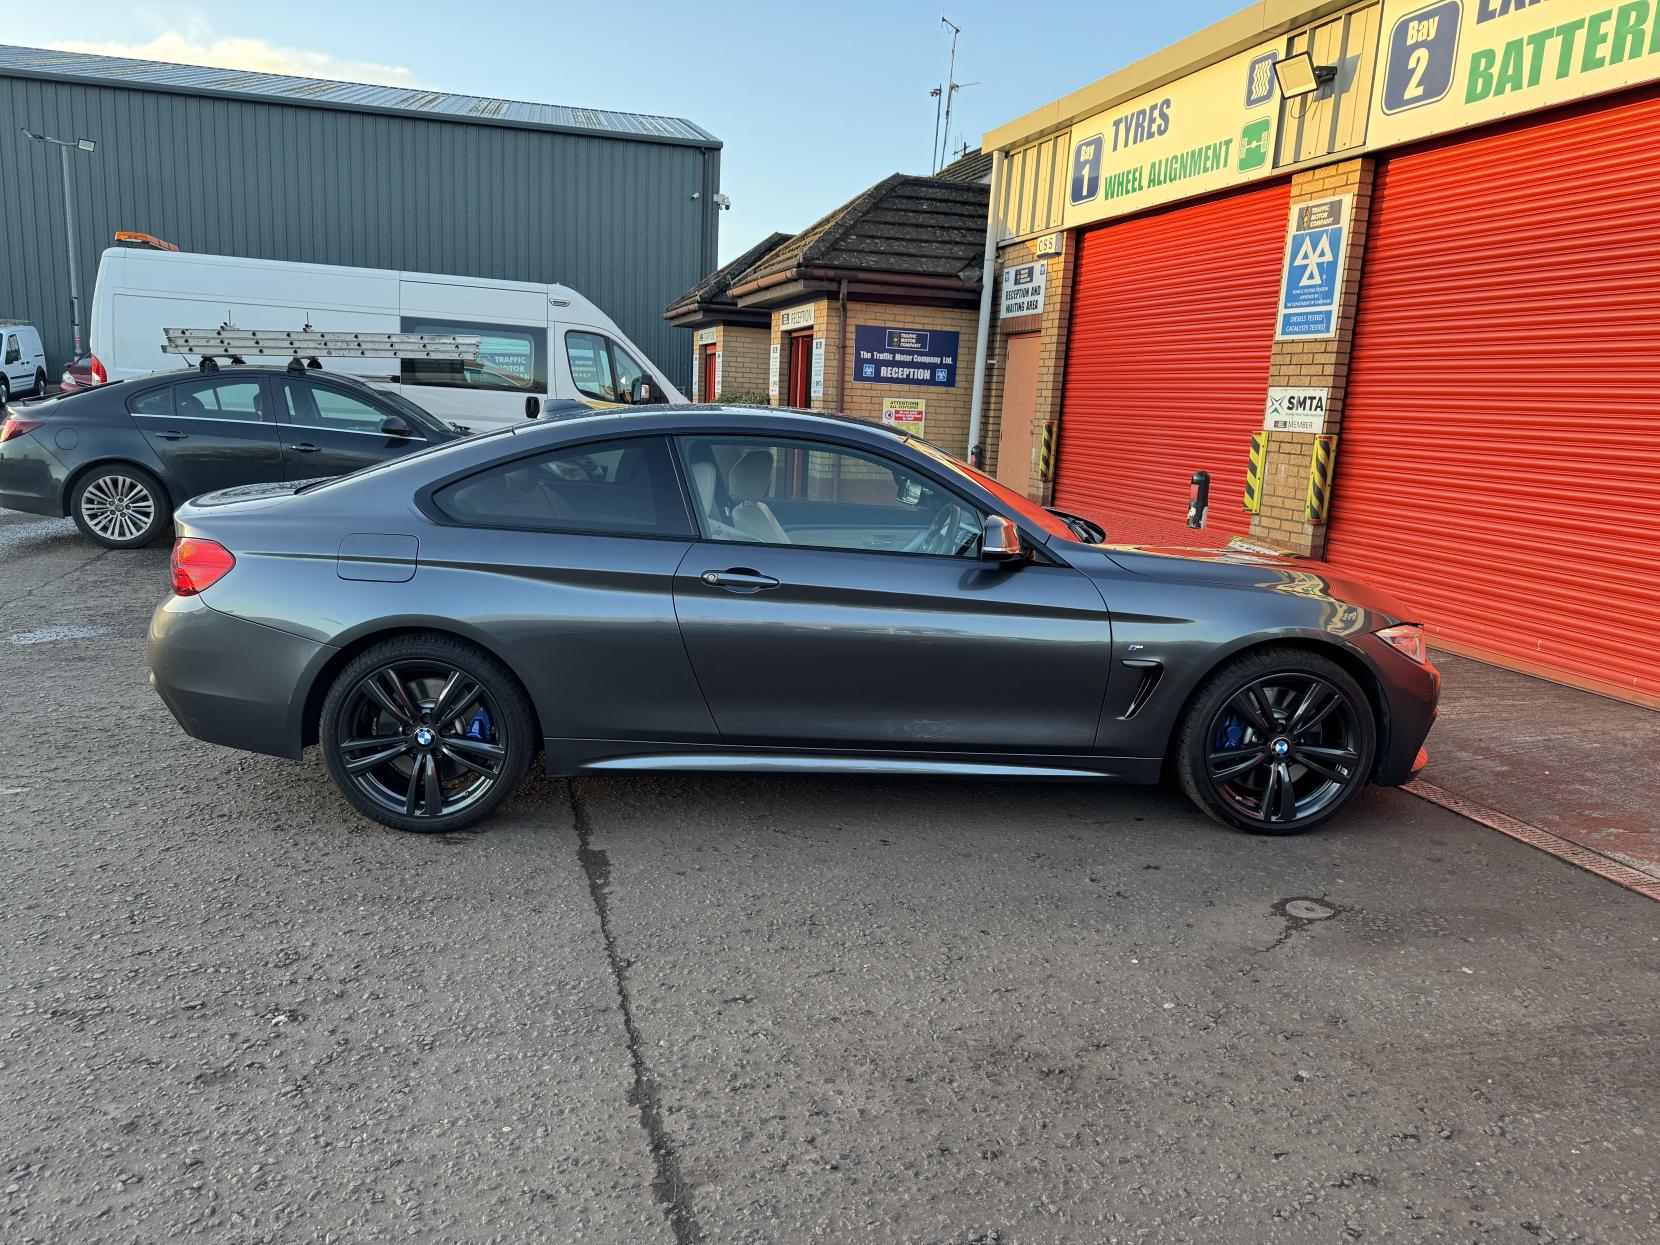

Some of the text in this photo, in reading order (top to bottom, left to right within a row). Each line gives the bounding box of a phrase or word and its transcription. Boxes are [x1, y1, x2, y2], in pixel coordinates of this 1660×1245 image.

[1406, 15, 1440, 46] Bay
[1403, 47, 1430, 100] 2
[1112, 98, 1171, 152] TYRES
[1080, 144, 1095, 162] Bay
[1104, 137, 1233, 201] WHEEL ALIGNMENT
[1081, 163, 1090, 196] 1
[1311, 204, 1330, 214] TRAFFIC
[1311, 212, 1328, 221] MOTOR
[1310, 217, 1334, 228] COMPANY
[1005, 285, 1041, 301] RECEPTION AND
[1005, 300, 1039, 314] WAITING AREA
[860, 351, 872, 359] The
[874, 352, 893, 361] Traffic
[895, 353, 913, 362] Motor
[913, 355, 941, 364] Company
[880, 366, 931, 380] RECEPTION
[1287, 395, 1324, 411] SMTA
[1288, 420, 1313, 429] MEMBER
